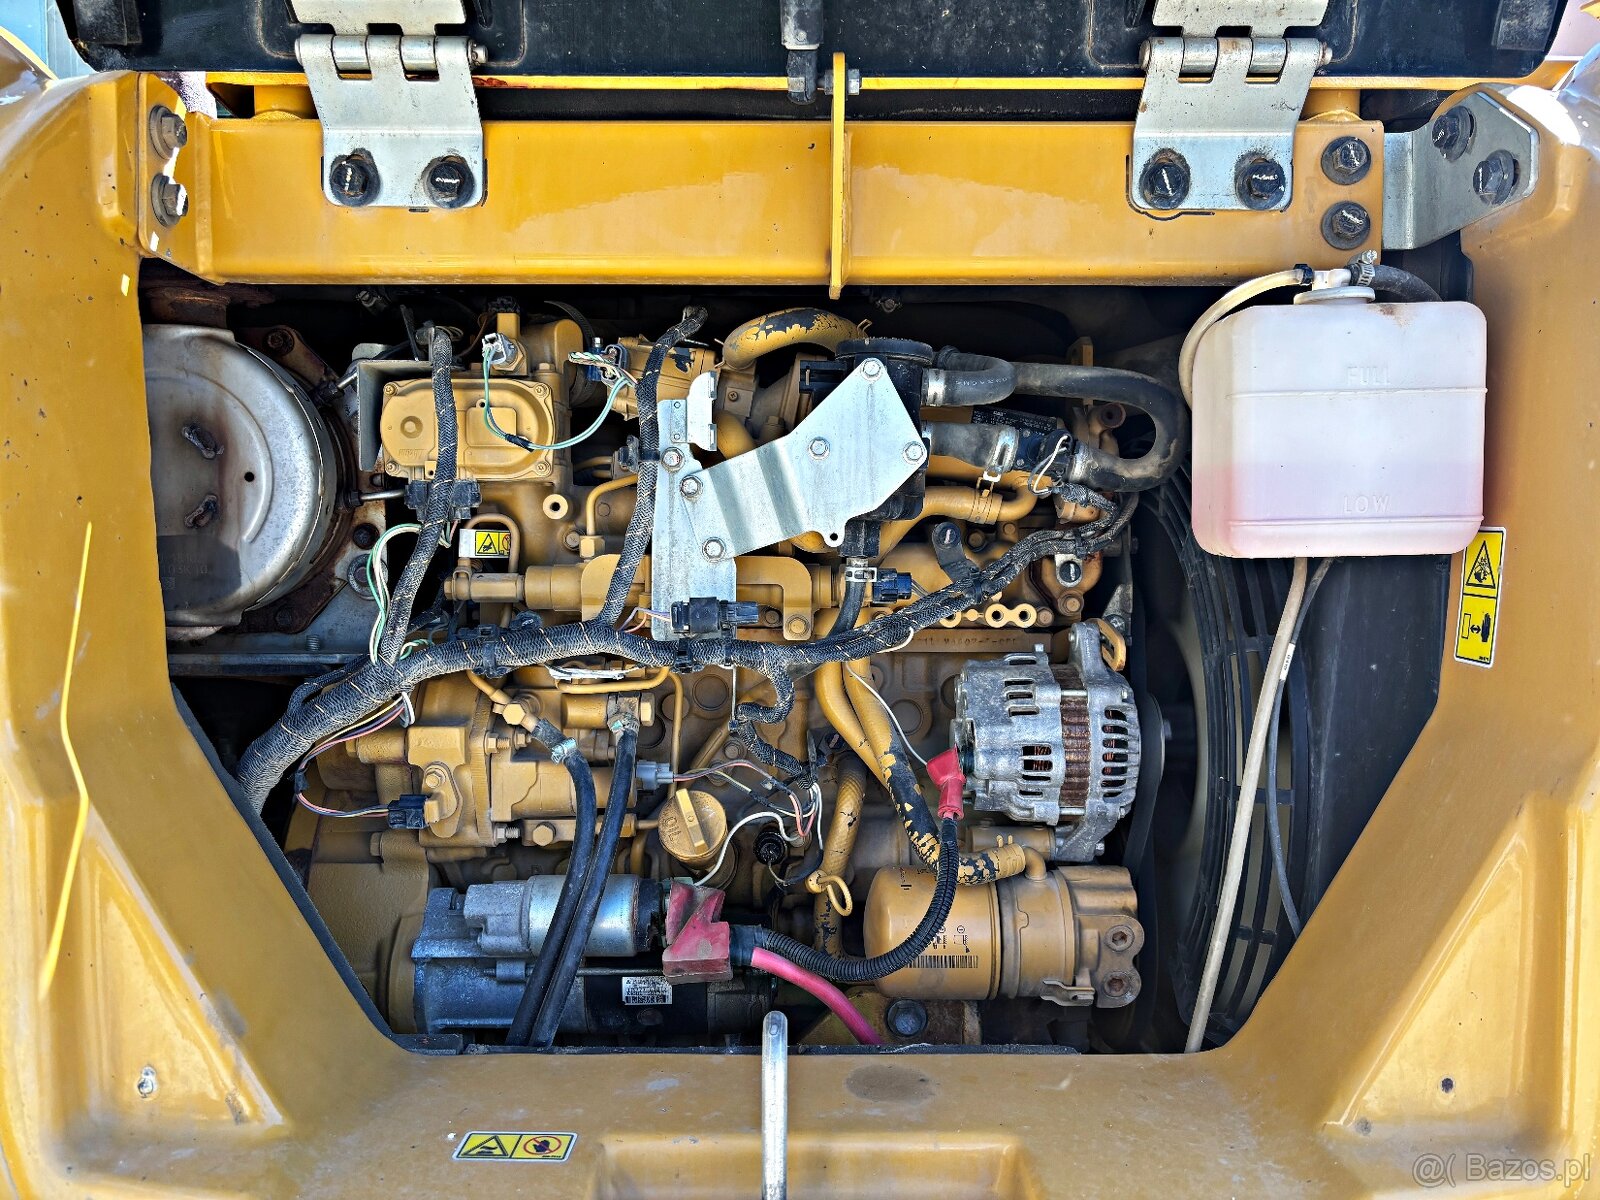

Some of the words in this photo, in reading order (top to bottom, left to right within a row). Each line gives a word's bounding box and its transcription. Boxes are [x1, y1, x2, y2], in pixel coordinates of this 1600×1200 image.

[1346, 364, 1392, 386] FULL
[1343, 494, 1391, 514] LOW
[664, 815, 682, 842] OIL
